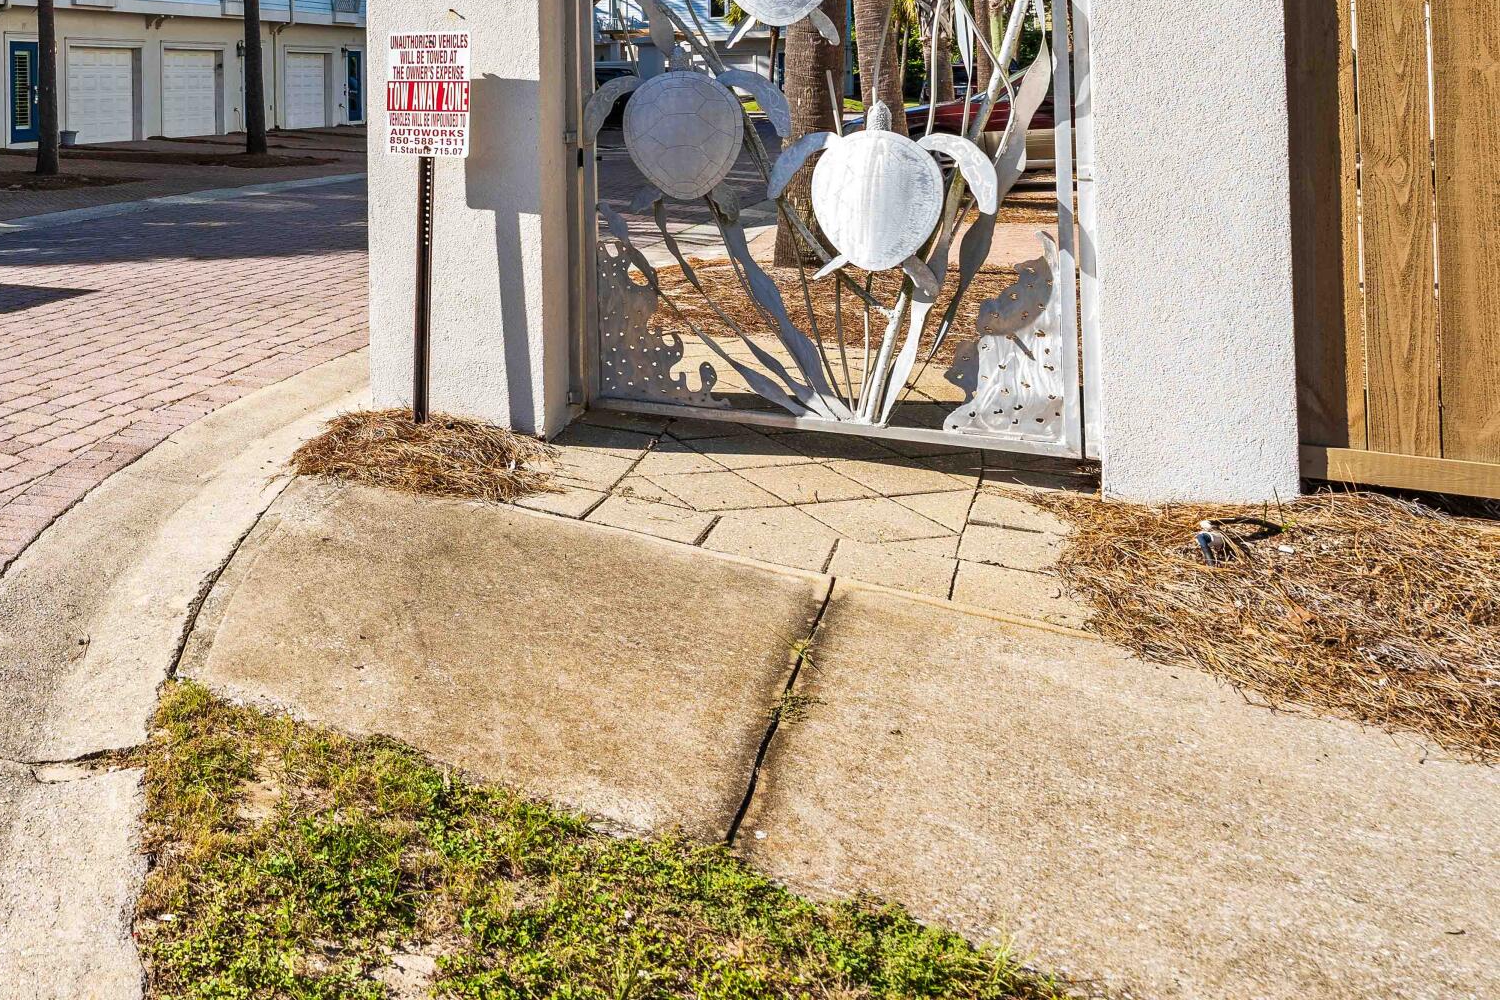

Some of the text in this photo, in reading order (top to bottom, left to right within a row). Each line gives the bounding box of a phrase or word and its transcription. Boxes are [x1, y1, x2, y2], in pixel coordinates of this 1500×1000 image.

[390, 34, 468, 49] UNAUTHORIZED VEHICLES
[400, 50, 458, 64] WILL BE TOWED AT
[393, 66, 464, 80] THE OWNER'S EXPENSE
[388, 82, 468, 111] TOW AWAY ZONE
[389, 112, 411, 127] VEHICLES
[423, 113, 430, 127] BE
[430, 113, 459, 128] IMPOUNDED
[460, 113, 466, 127] TO
[390, 128, 464, 138] AUTOWORKS
[389, 137, 464, 146] 850-588-1511
[434, 147, 463, 156] 715.07
